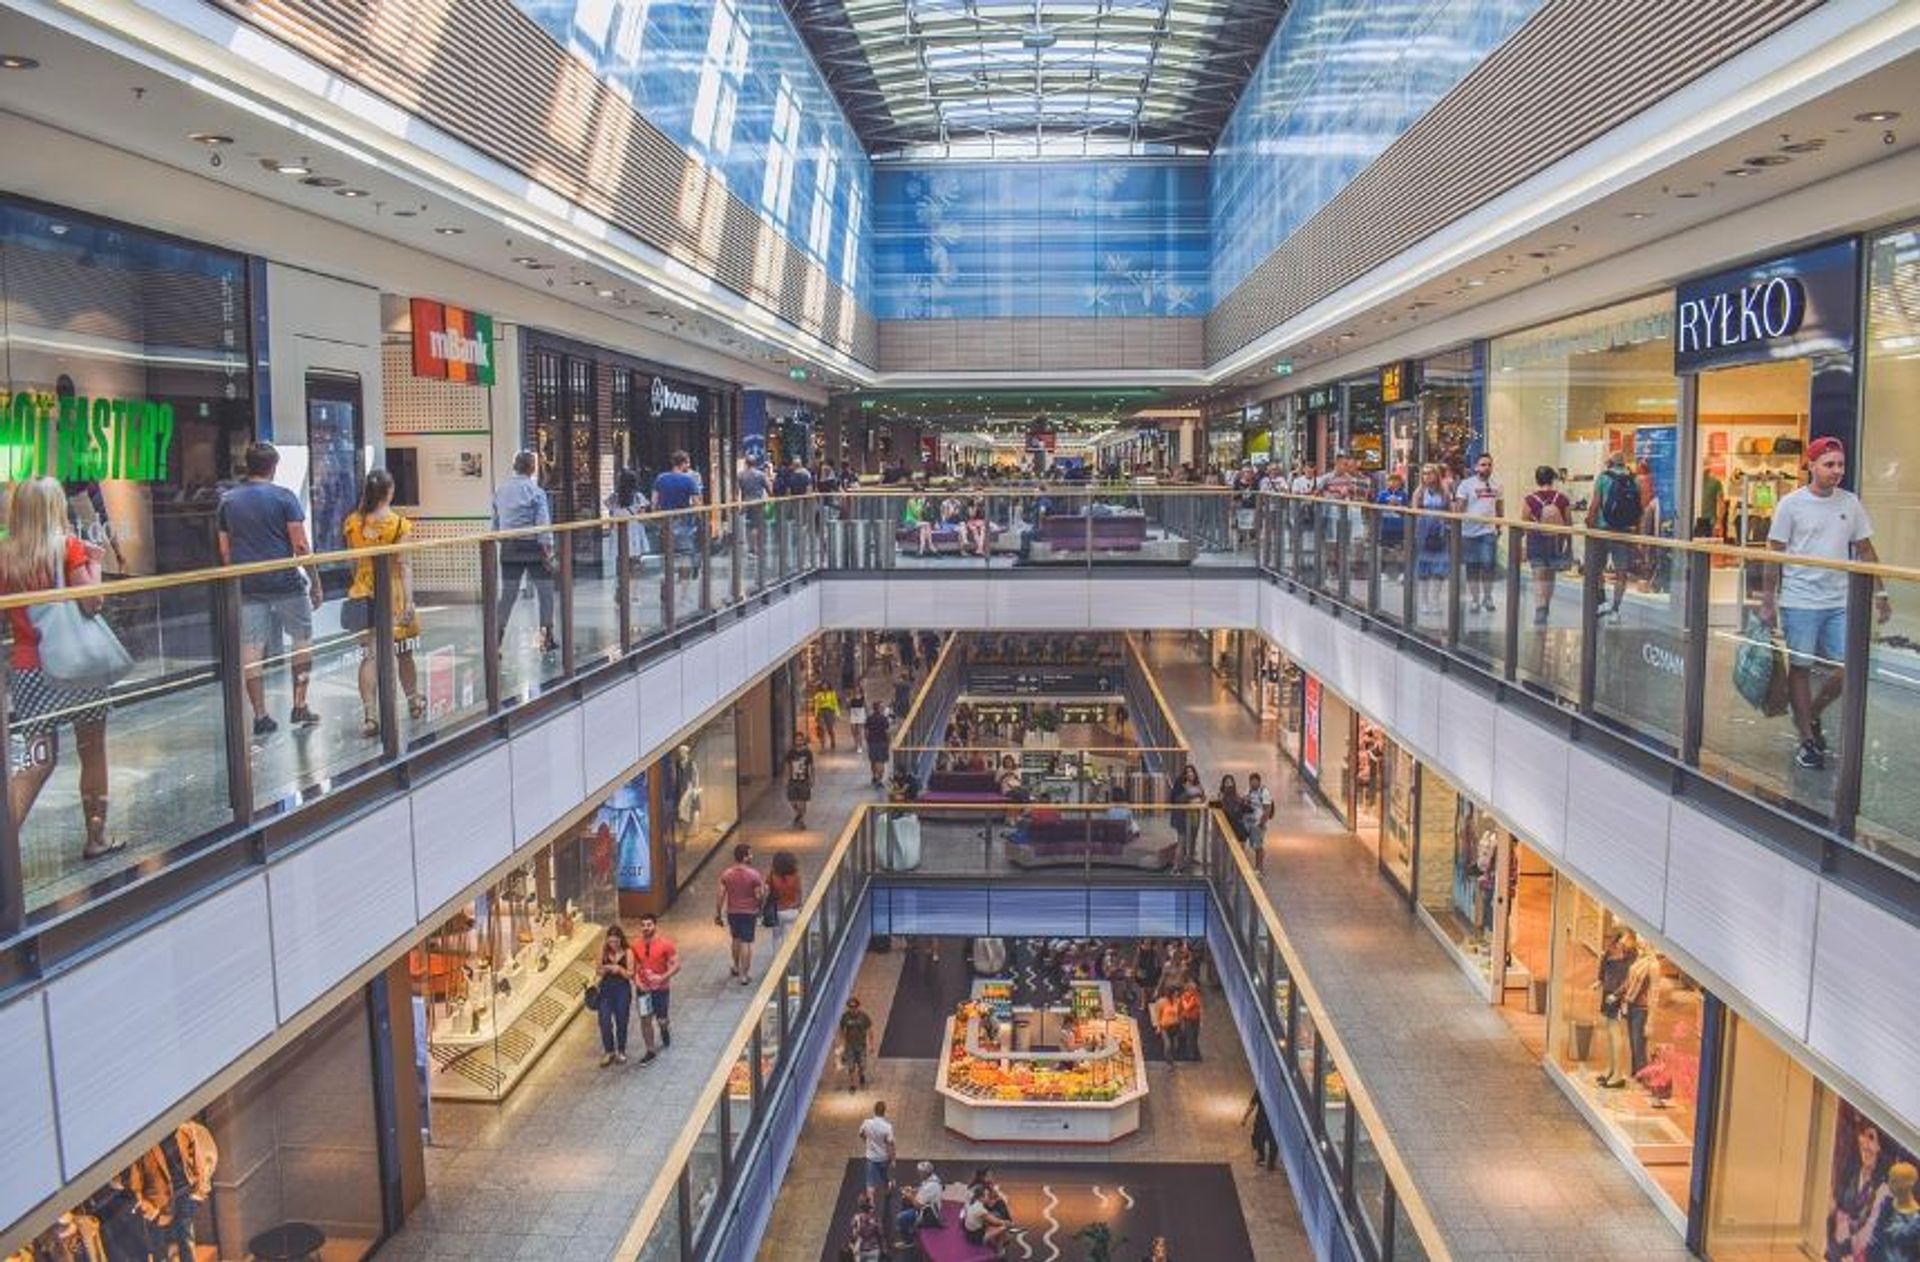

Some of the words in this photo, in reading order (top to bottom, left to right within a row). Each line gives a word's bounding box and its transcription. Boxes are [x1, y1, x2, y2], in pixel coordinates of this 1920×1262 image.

[429, 327, 489, 367] mBank
[1679, 277, 1791, 352] RYŁKO
[57, 397, 174, 482] FASTER?
